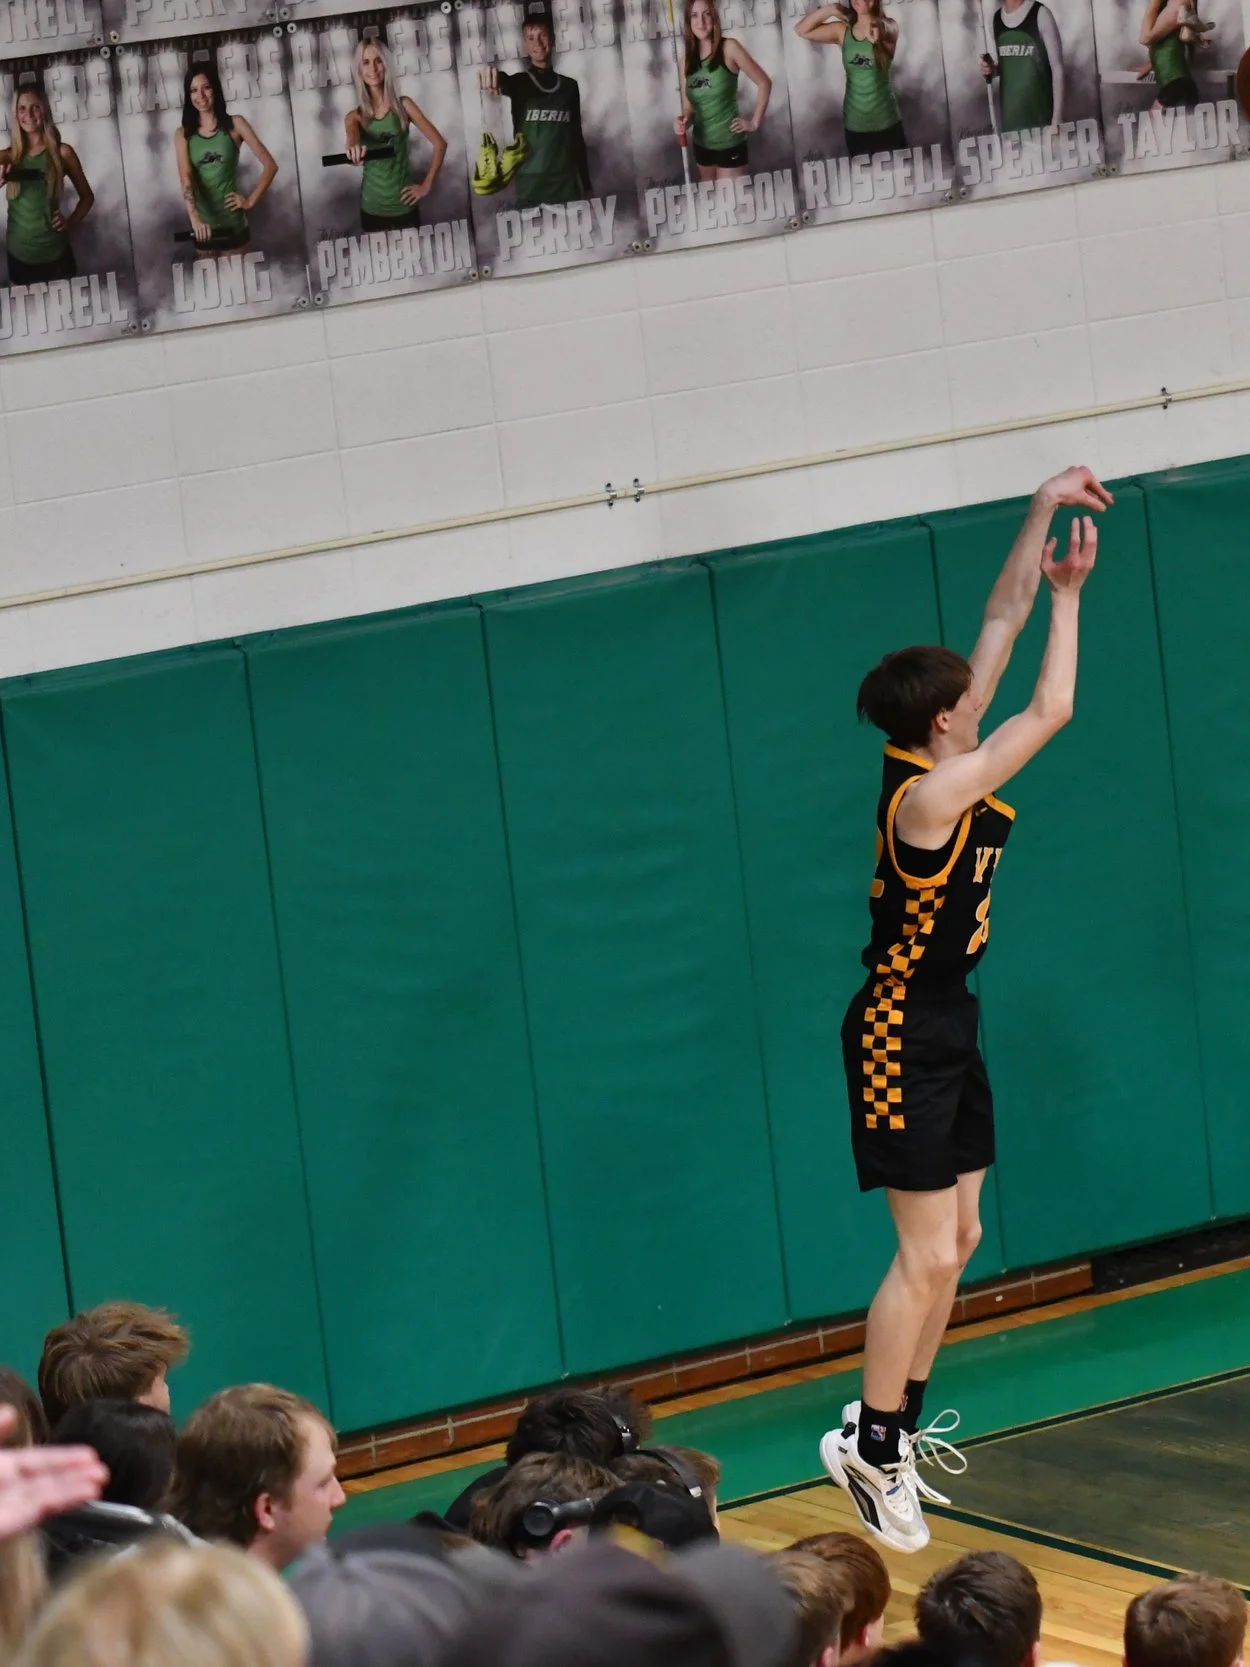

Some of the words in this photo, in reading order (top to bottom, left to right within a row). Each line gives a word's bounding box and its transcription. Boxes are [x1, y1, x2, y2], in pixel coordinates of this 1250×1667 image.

[525, 109, 571, 122] IBERIA
[1117, 98, 1242, 161] TAYLOR
[802, 143, 952, 210] RUSSELL
[958, 117, 1100, 187] SPENCER
[495, 194, 617, 262] PERRY
[644, 168, 796, 238] PETERSON
[172, 250, 273, 314] LONG
[316, 218, 472, 291] PEMBERTON
